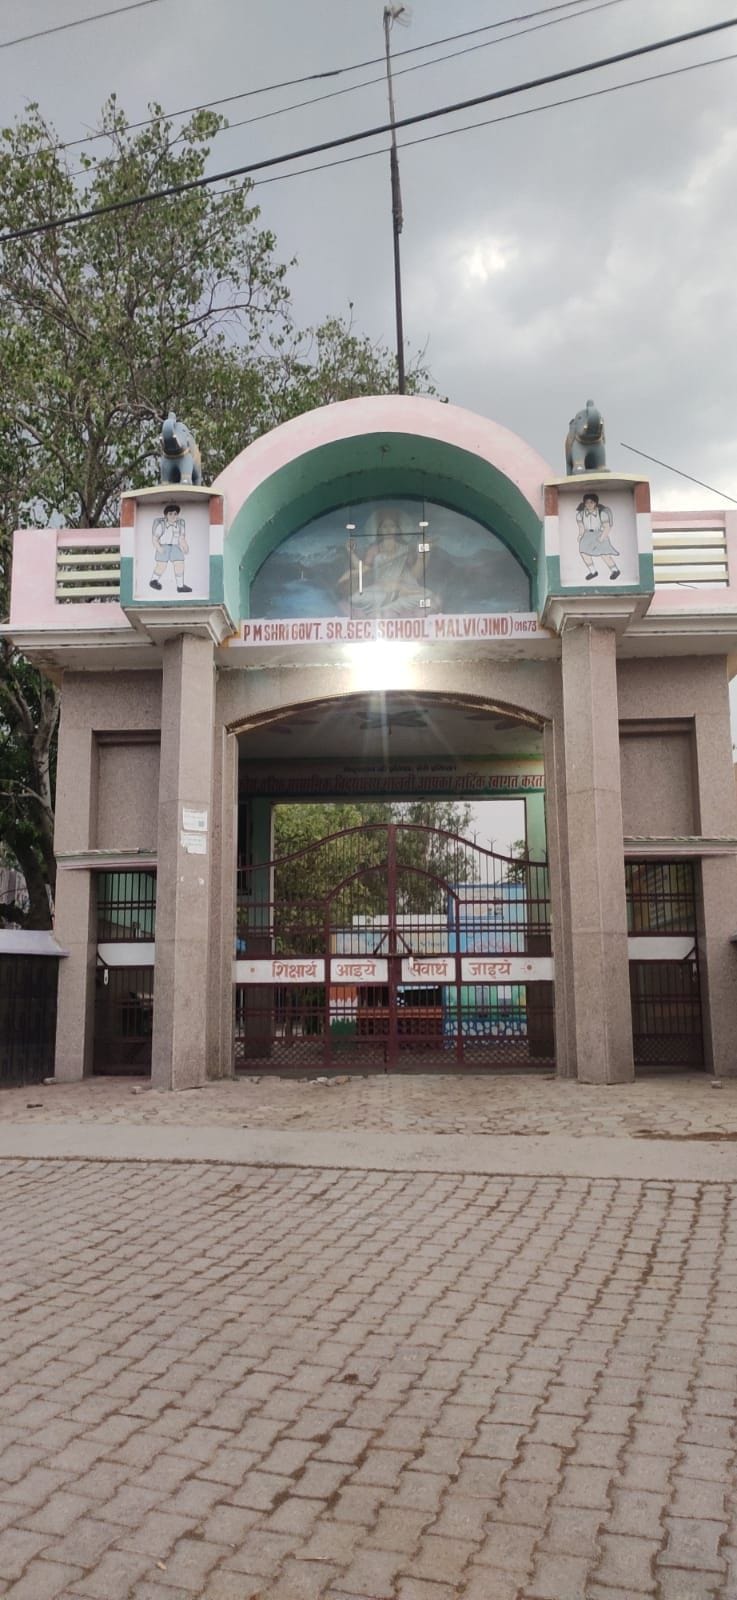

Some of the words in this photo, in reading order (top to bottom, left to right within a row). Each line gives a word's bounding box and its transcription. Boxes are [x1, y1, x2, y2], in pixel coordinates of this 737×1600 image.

[244, 624, 251, 641] P
[253, 624, 262, 641] M
[291, 623, 323, 640] GOVT.
[378, 619, 430, 640] SCHOOL
[337, 960, 376, 980] आइये
